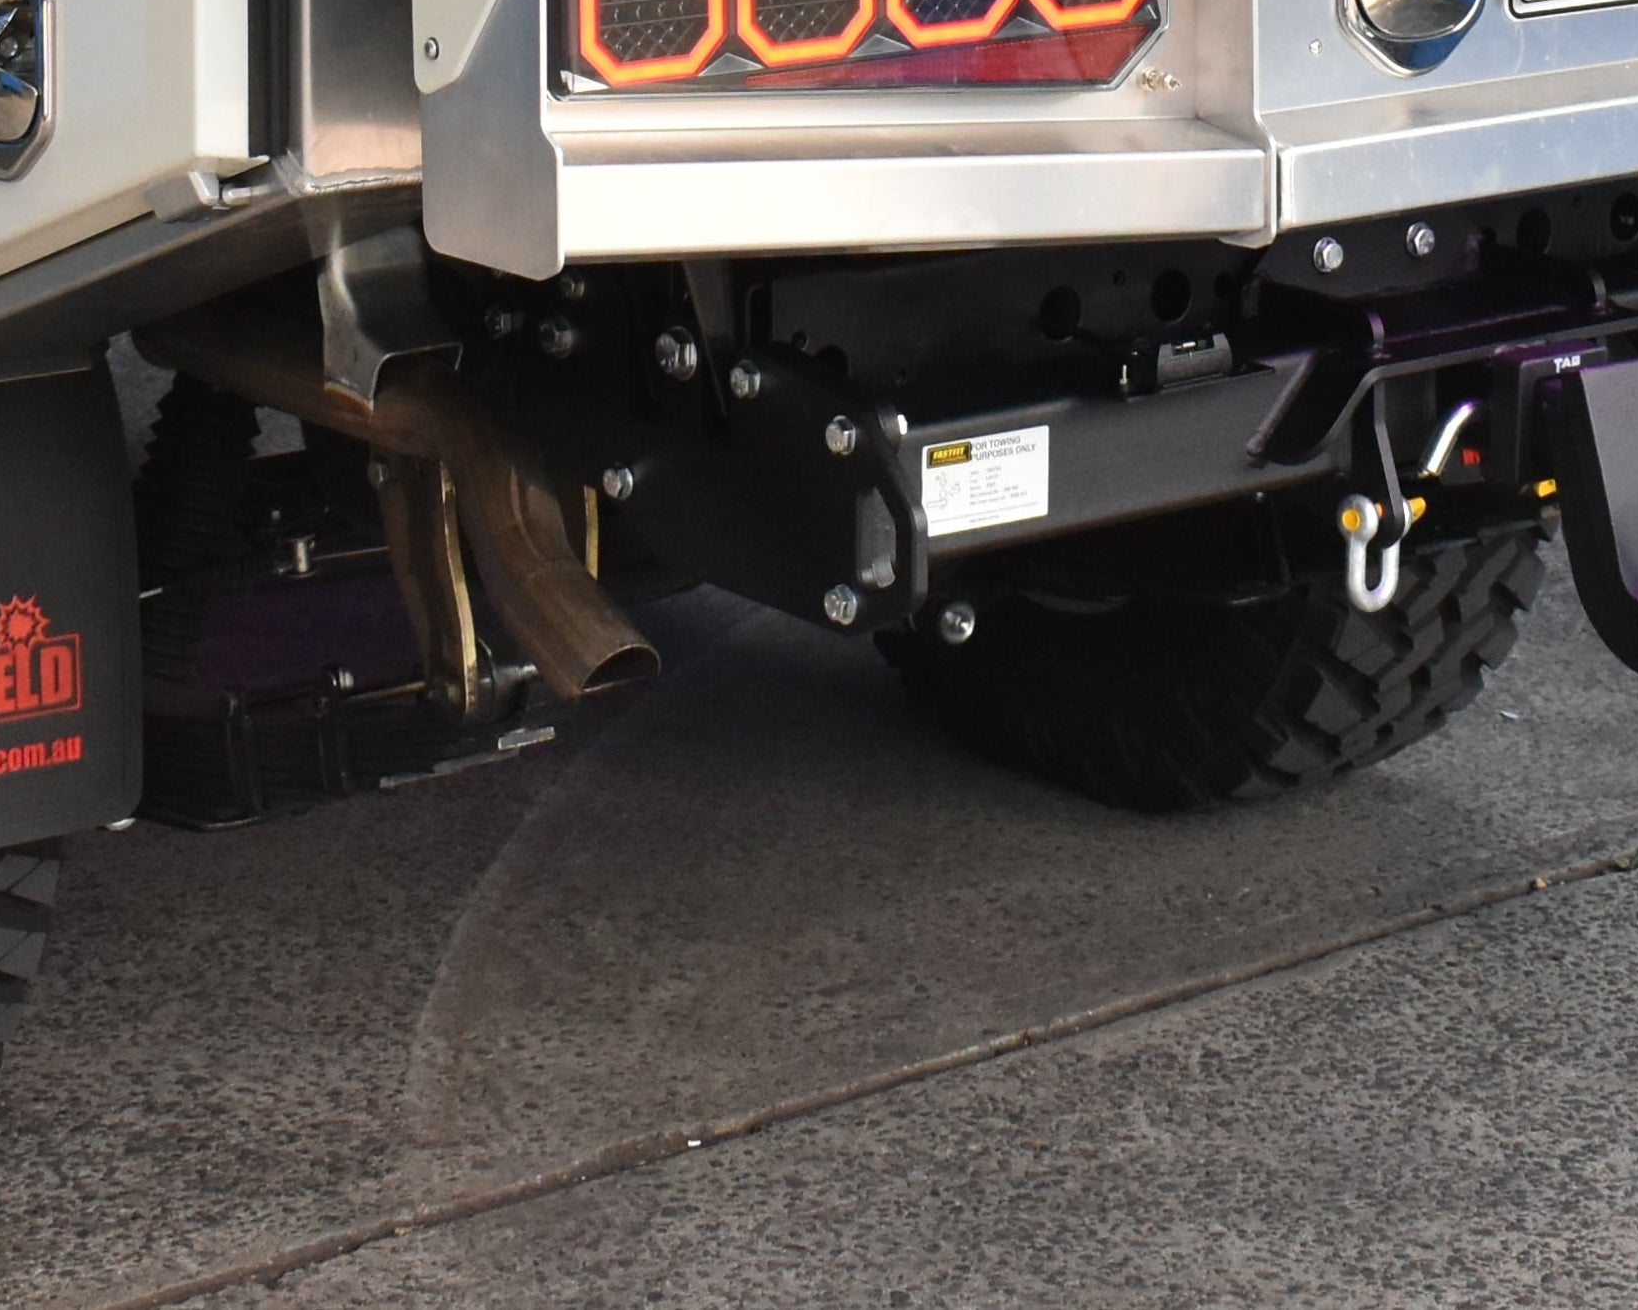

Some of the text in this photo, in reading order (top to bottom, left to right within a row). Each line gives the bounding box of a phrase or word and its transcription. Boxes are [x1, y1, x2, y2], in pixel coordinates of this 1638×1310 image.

[971, 441, 988, 452] FOR
[989, 436, 1021, 450] TOWING
[971, 447, 1014, 462] PURPOSES
[1015, 442, 1037, 454] ONLY
